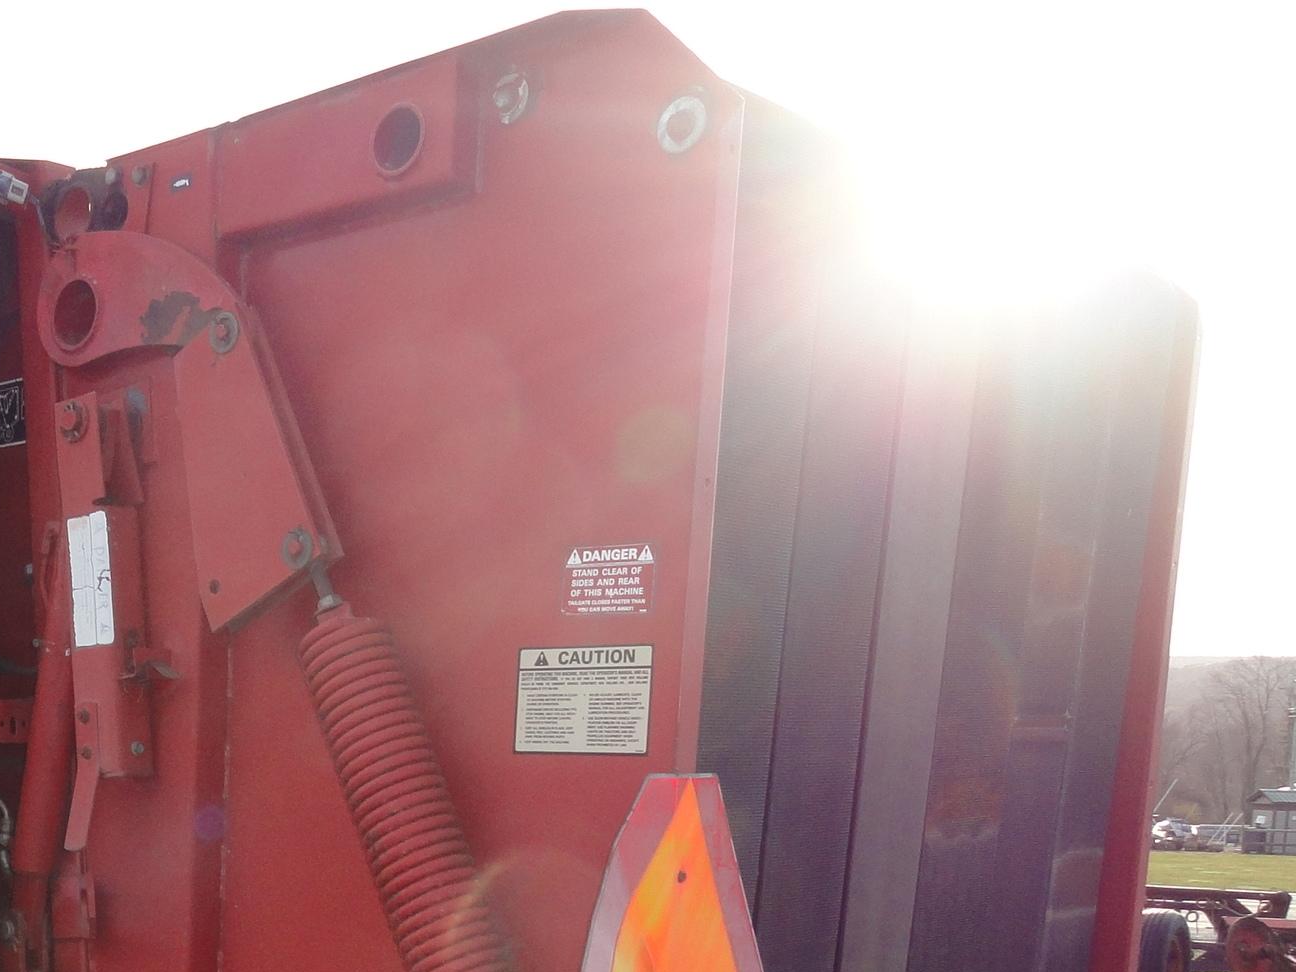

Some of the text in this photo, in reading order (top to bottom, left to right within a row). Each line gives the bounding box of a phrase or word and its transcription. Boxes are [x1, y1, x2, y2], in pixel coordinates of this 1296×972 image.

[583, 548, 638, 562] DANGER
[572, 566, 643, 577] STAND CLEAR OF
[571, 577, 640, 587] SIDES AND REAR
[570, 587, 644, 597] OF THIS MACHINE
[558, 649, 636, 665] CAUTION
